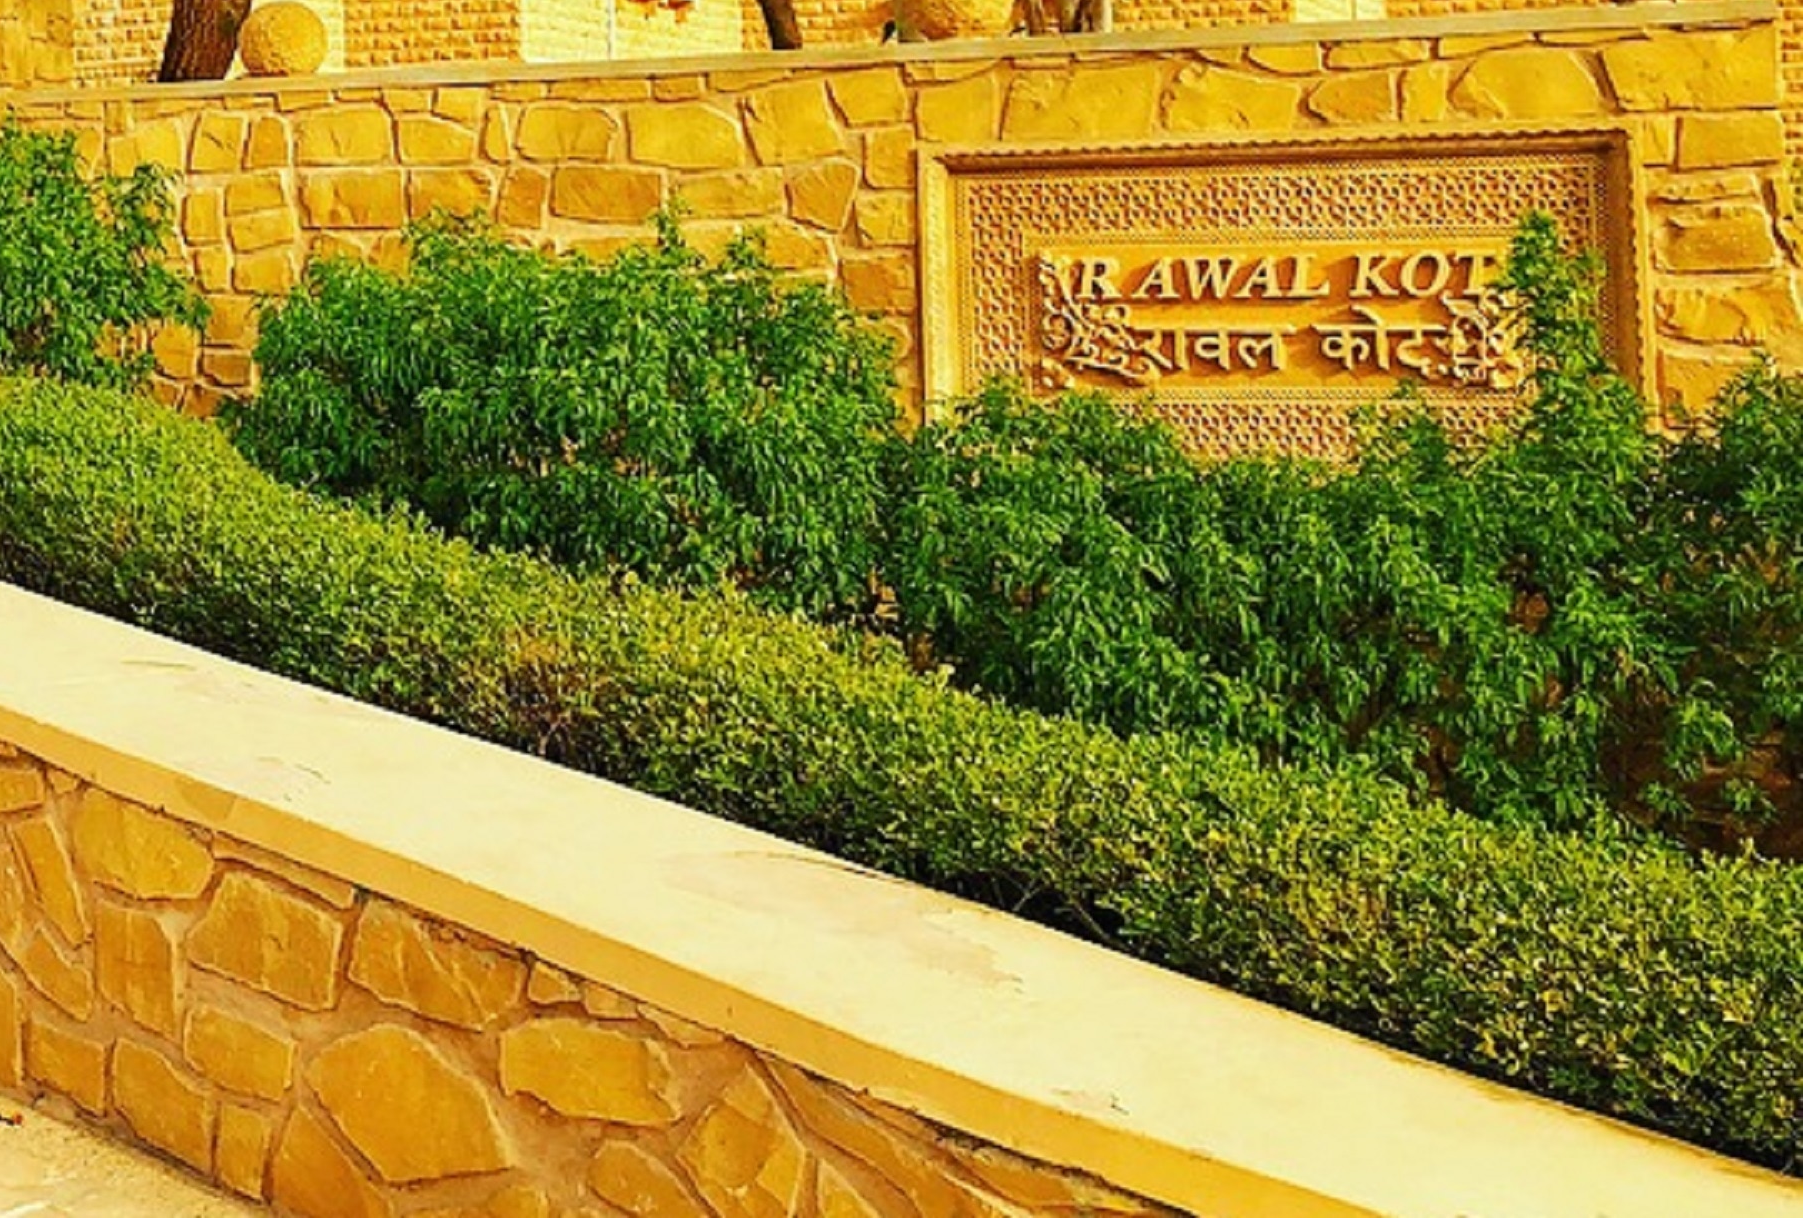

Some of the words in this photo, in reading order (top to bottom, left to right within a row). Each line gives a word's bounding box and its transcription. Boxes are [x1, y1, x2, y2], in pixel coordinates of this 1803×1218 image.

[1074, 254, 1331, 300] RAWAL
[1349, 249, 1498, 298] KOT
[1133, 323, 1297, 372] रावल
[1310, 304, 1447, 372] कोट
